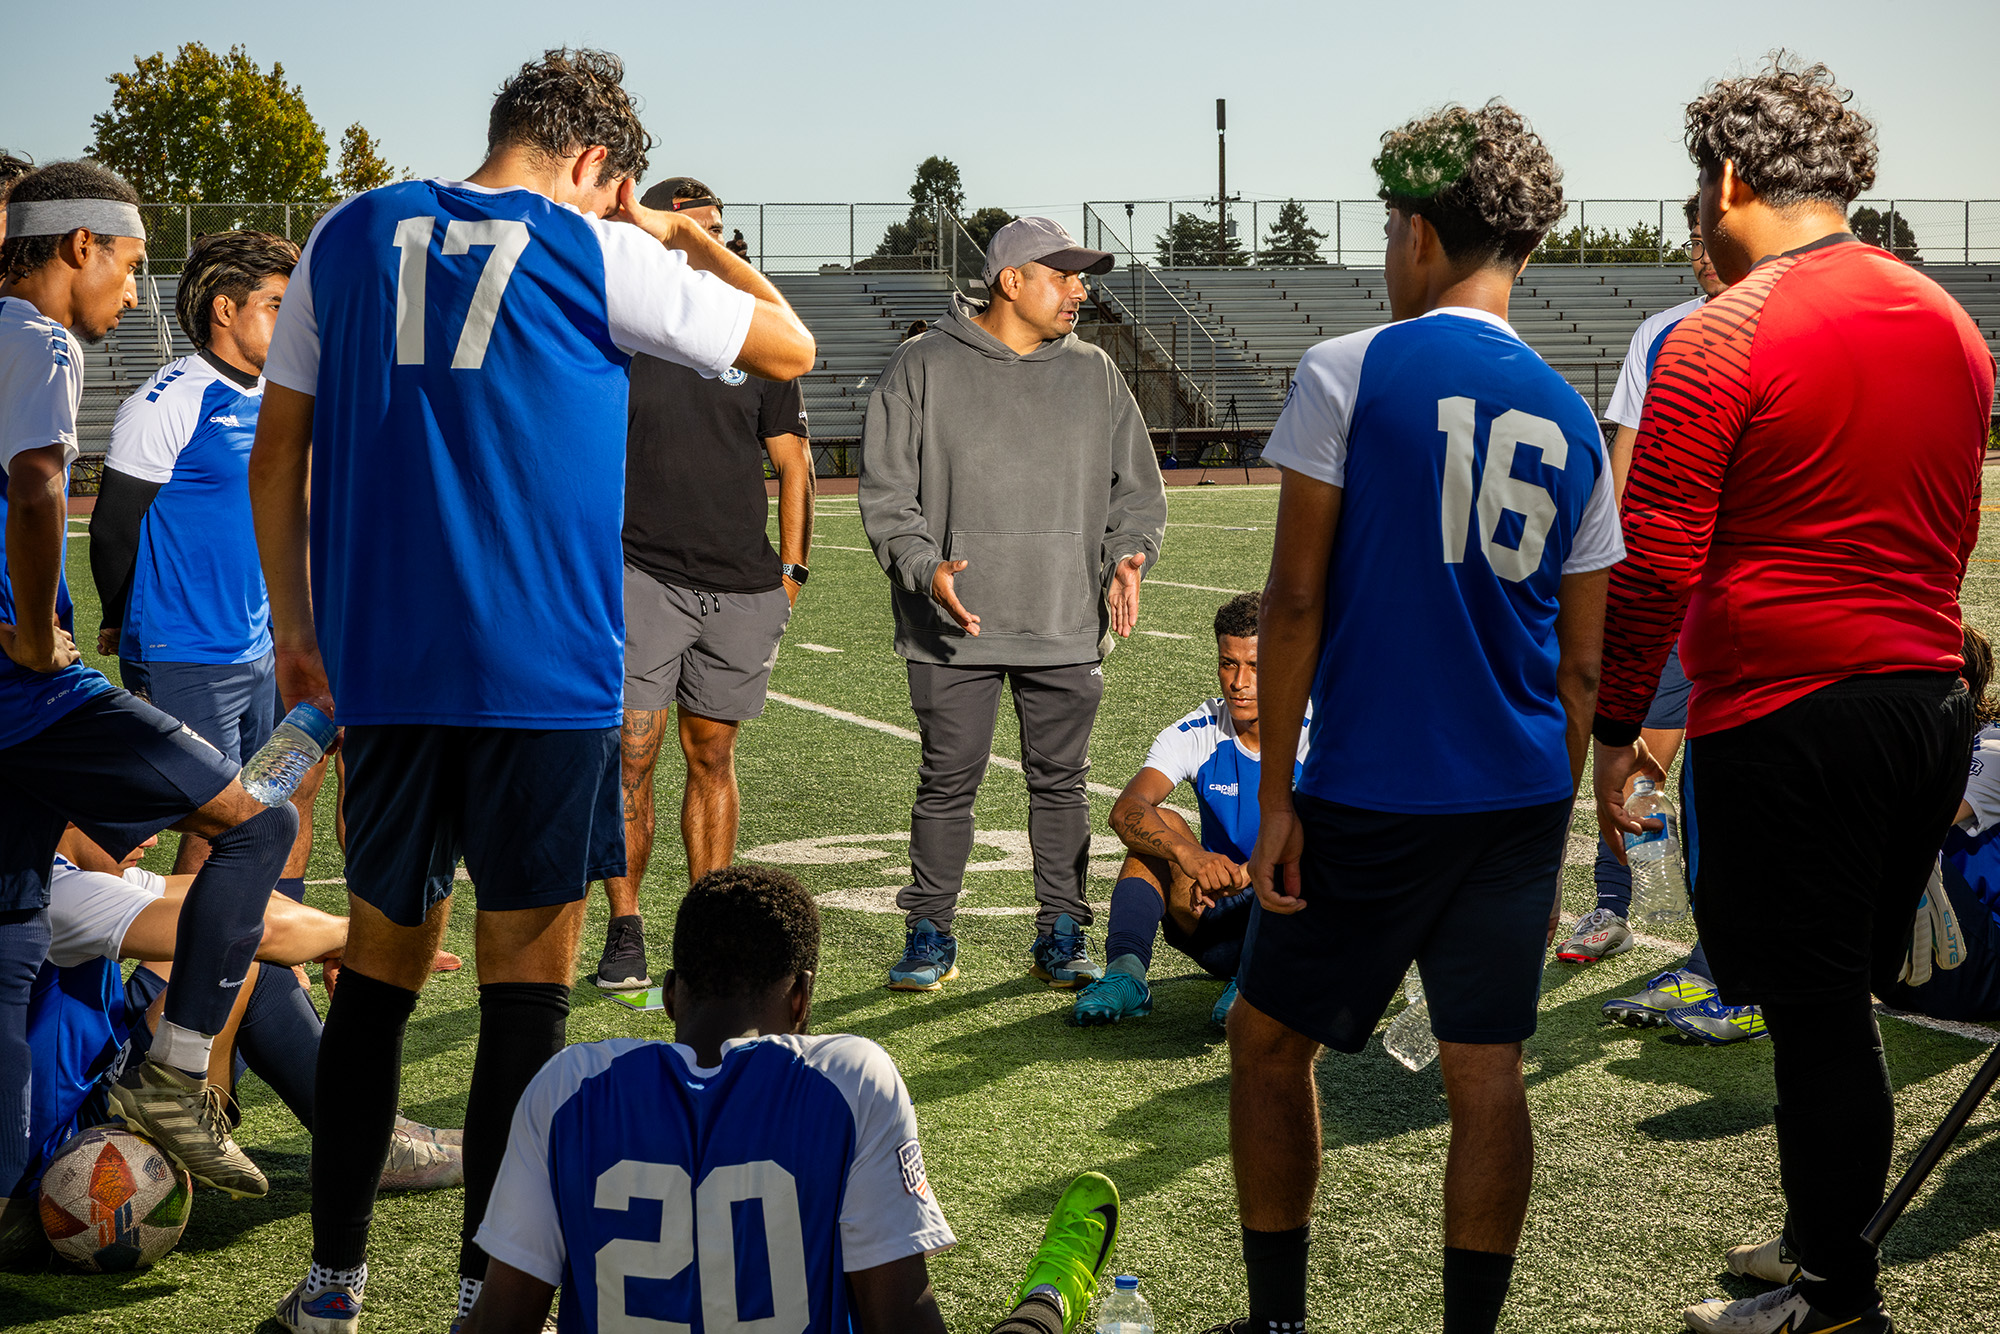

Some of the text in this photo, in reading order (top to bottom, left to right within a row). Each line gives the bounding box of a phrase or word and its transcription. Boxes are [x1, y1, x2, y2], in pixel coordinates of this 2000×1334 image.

[393, 216, 531, 370] 17
[1438, 396, 1569, 584] 16
[1583, 931, 1610, 947] F50
[1943, 910, 1960, 965] ELITE
[593, 1159, 811, 1334] 20
